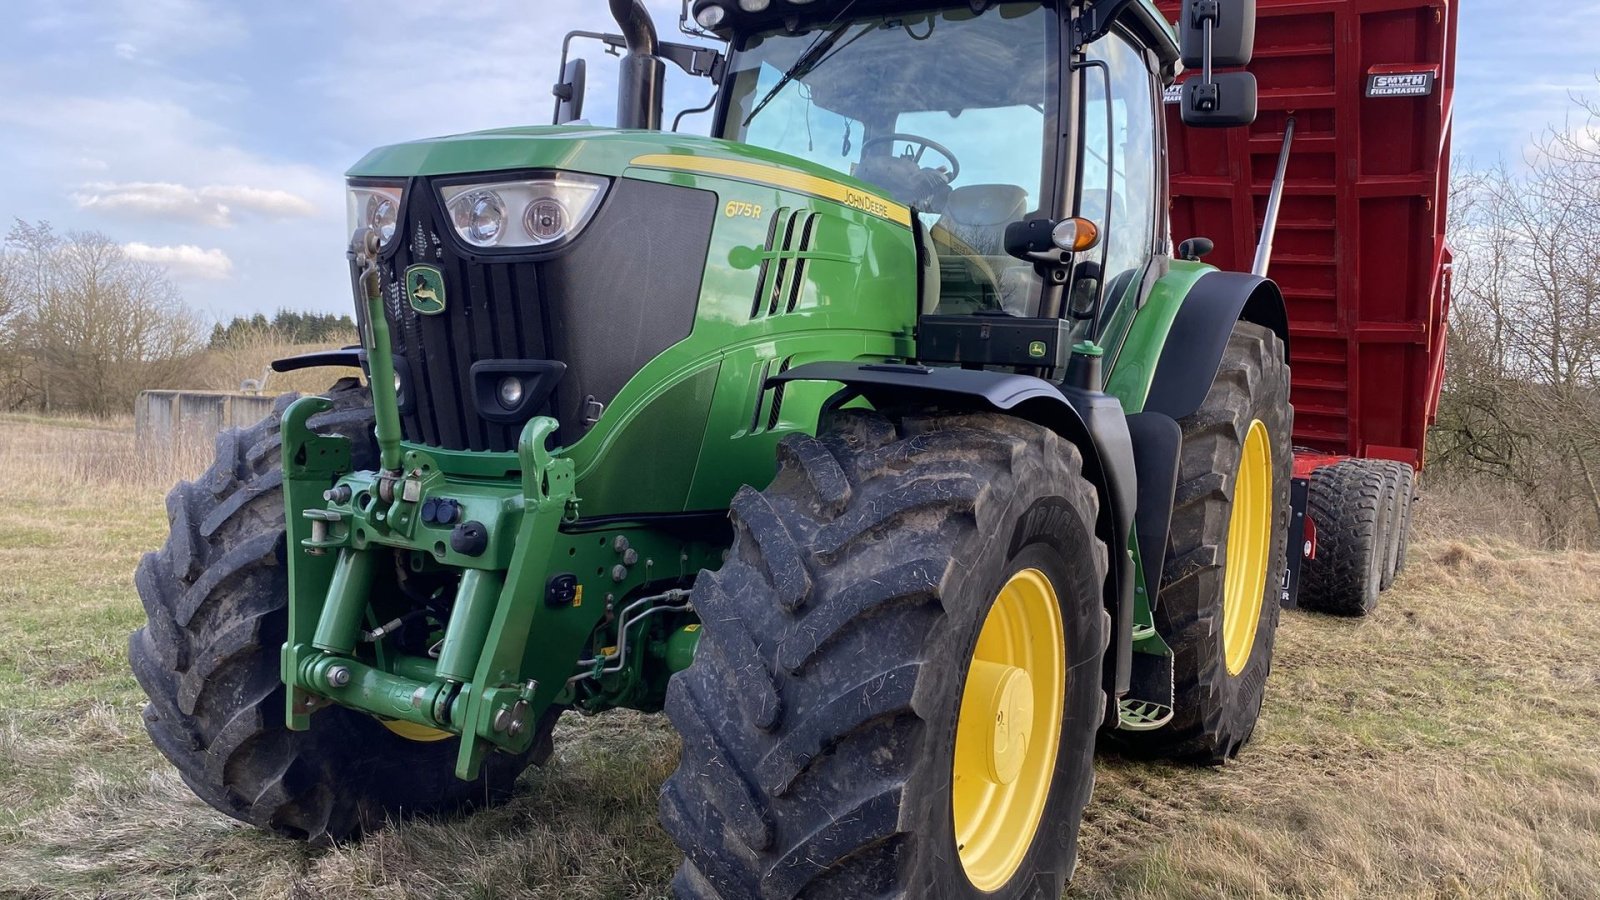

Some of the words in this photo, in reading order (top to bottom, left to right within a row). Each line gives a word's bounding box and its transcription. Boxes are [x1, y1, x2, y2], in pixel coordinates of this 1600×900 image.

[1377, 76, 1423, 86] SMYTH
[844, 189, 865, 208] JOHN
[865, 196, 888, 216] DEERE
